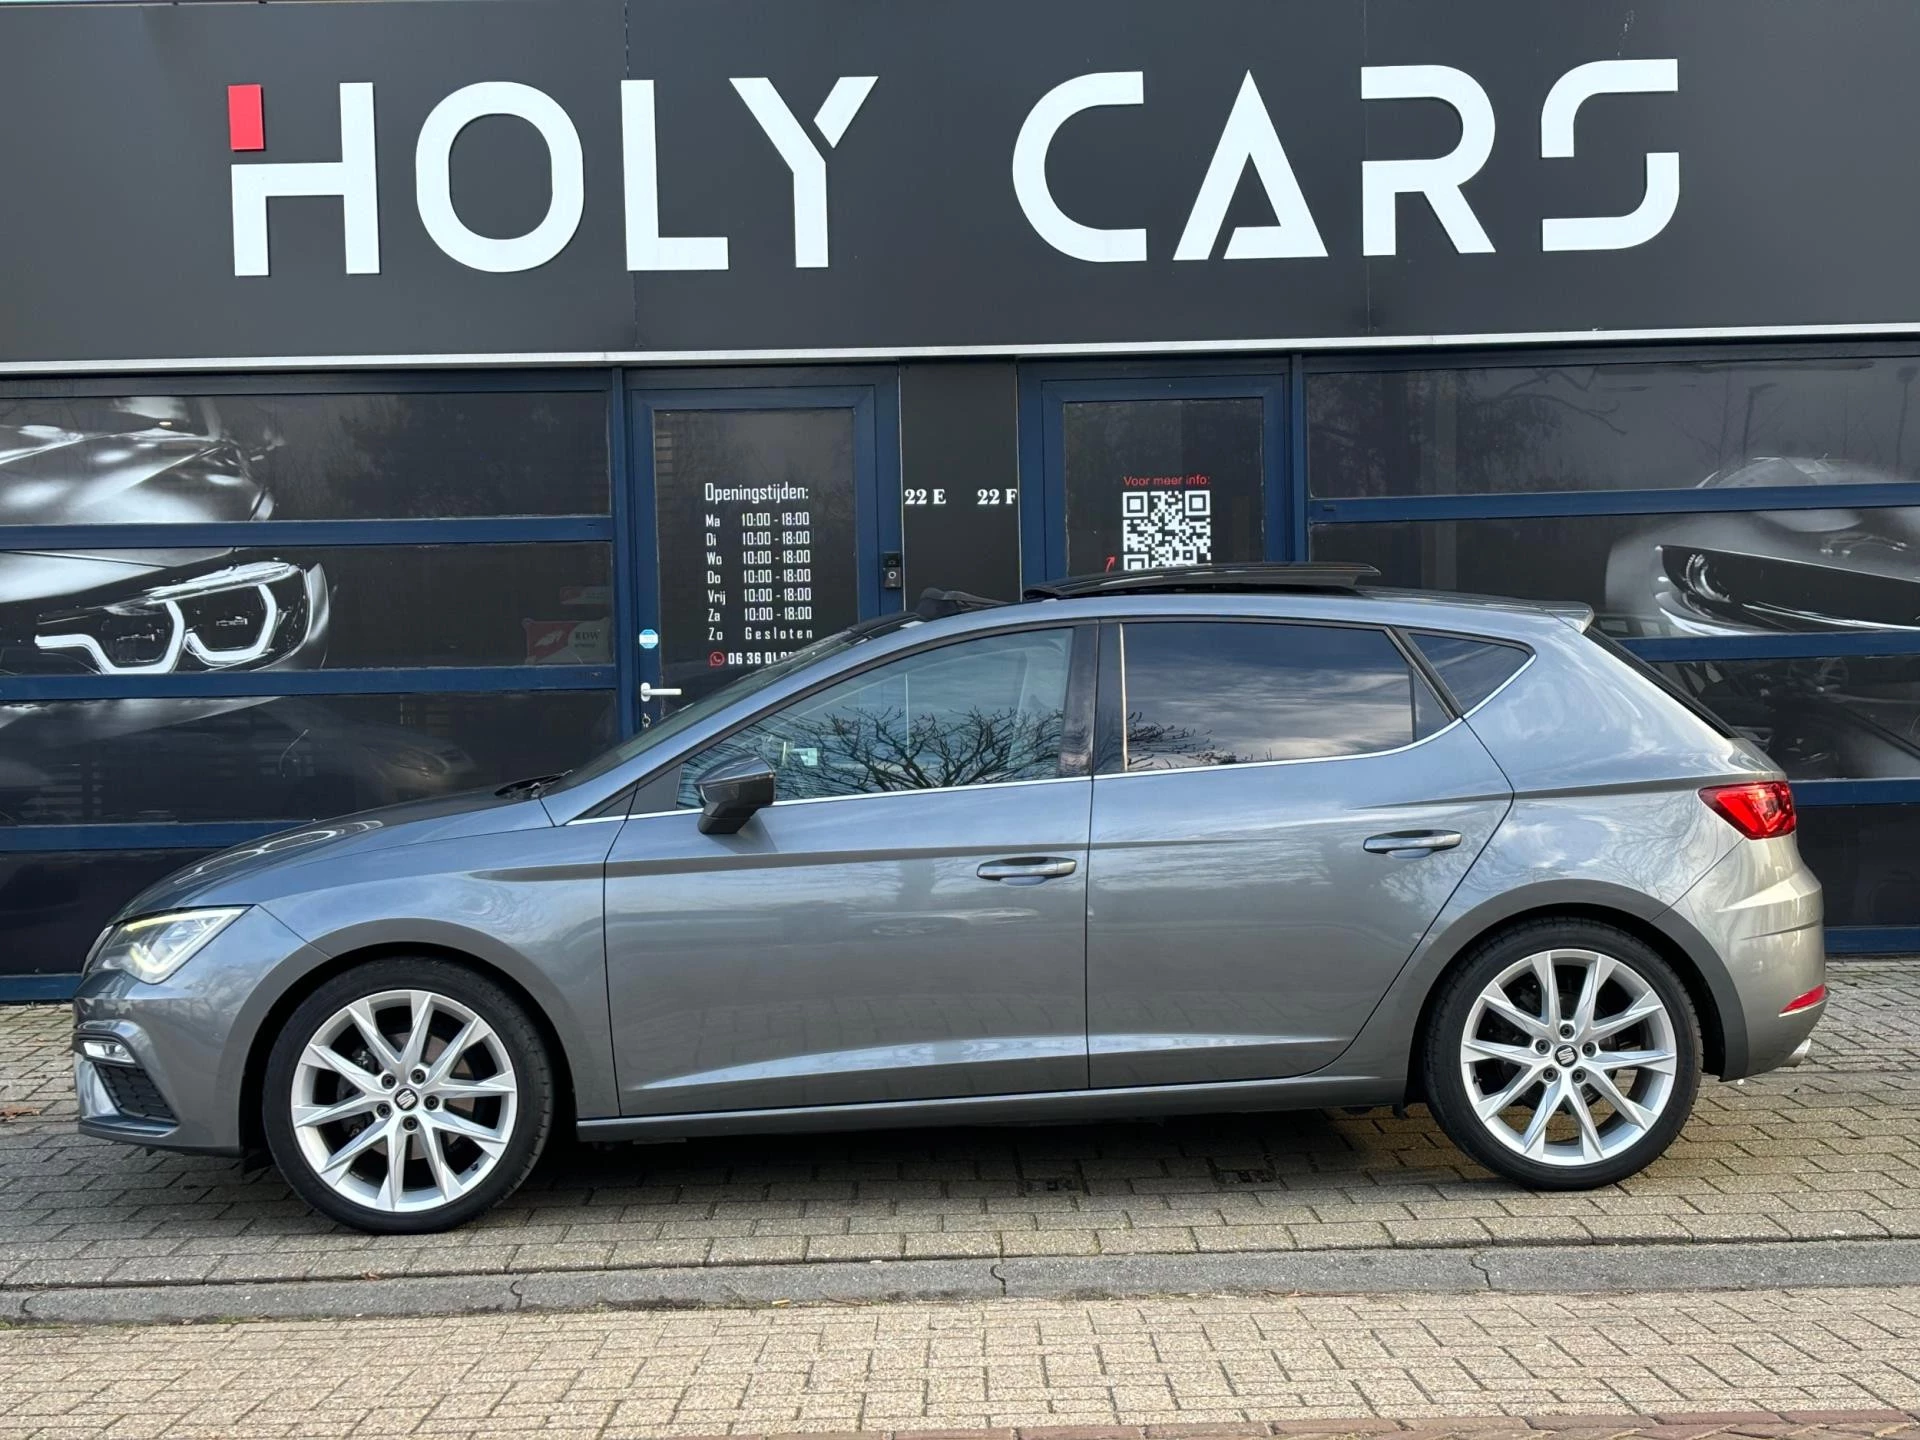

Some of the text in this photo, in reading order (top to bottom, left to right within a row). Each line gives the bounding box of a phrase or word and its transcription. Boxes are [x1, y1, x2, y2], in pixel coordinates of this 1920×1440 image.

[227, 57, 1681, 276] HOLY CARS
[1123, 473, 1211, 487] Voor meer info:
[705, 481, 809, 505] Openingstijden:
[904, 488, 947, 505] 22 E
[977, 488, 1018, 505] 22 F
[706, 514, 720, 527] Ma
[742, 513, 770, 526] 10:00
[782, 512, 810, 526] 18:00
[706, 533, 716, 546] Di
[743, 532, 771, 545] 10:00
[782, 531, 810, 544] 18:00
[707, 552, 722, 565] Wo
[743, 550, 772, 564] 10:00
[783, 550, 811, 563] 18:00
[708, 571, 721, 584] Do
[744, 569, 772, 583] 10:00
[784, 569, 812, 582] 18:00
[708, 590, 726, 605] Vrij
[744, 588, 773, 602] 10:00
[784, 588, 812, 601] 18:00
[708, 608, 720, 622] Za
[745, 607, 773, 621] 10:00
[785, 607, 813, 620] 18:00
[708, 627, 813, 641] Zo Gesloten
[728, 652, 743, 665] 06
[746, 652, 761, 665] 36
